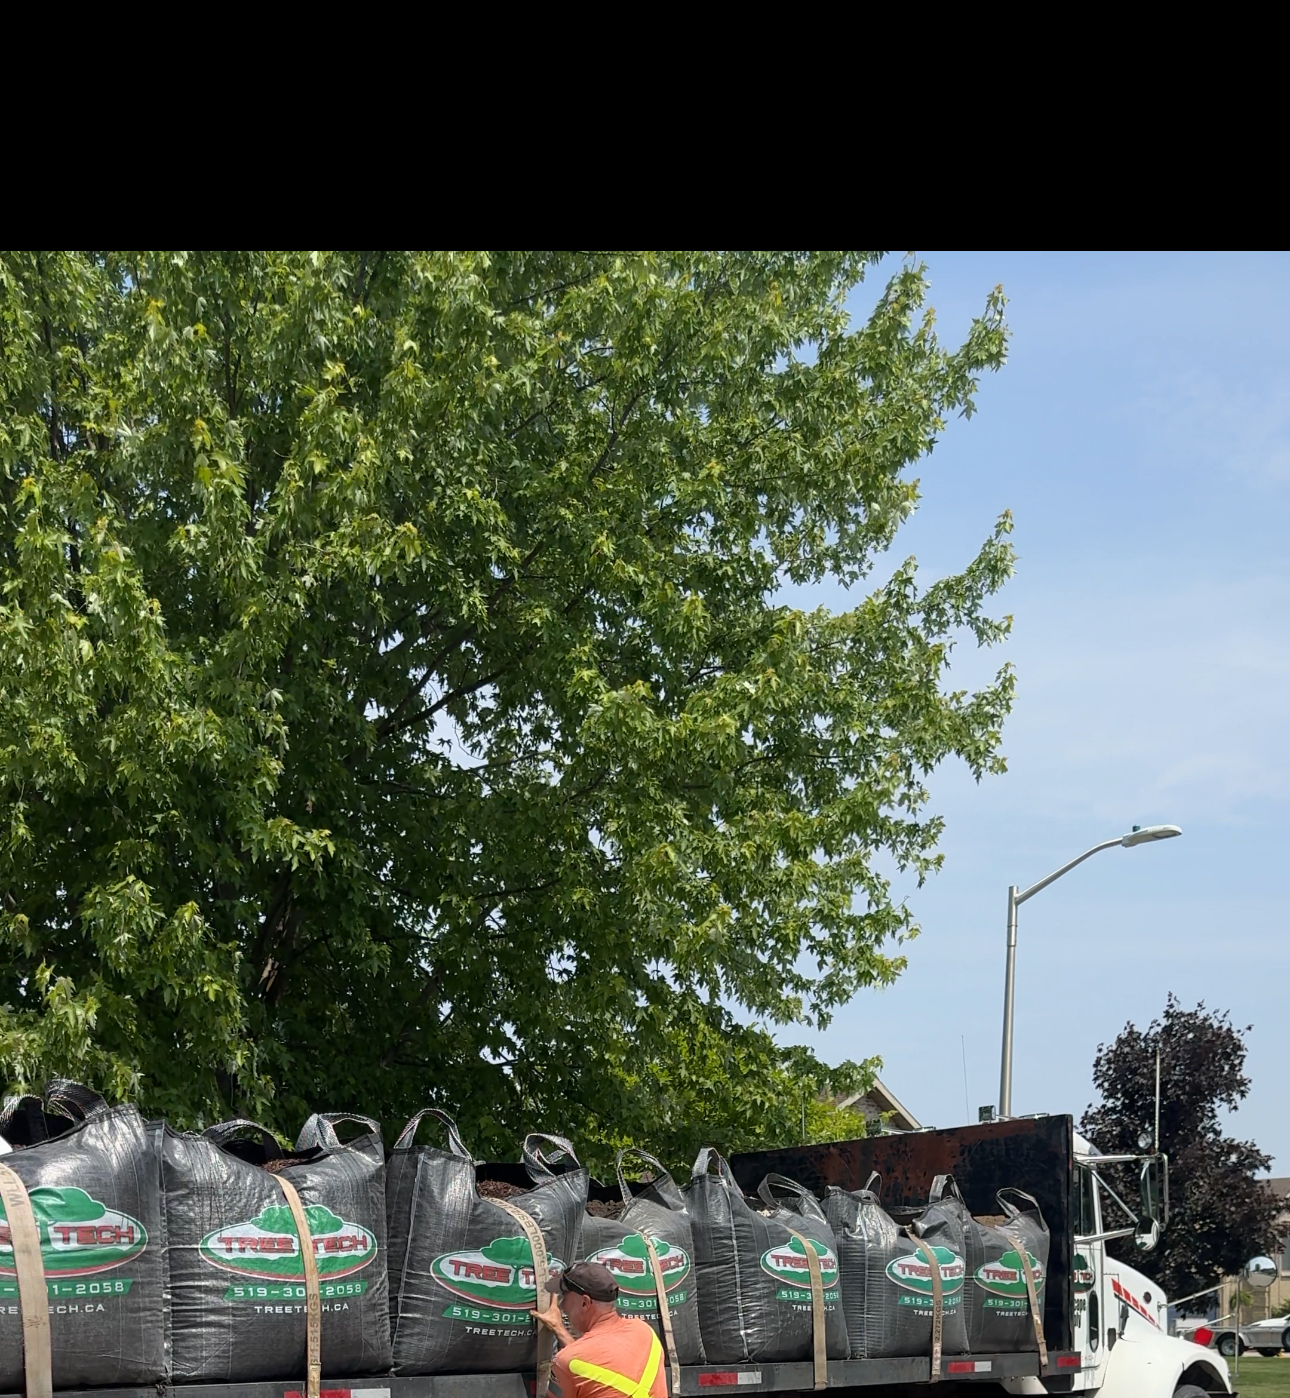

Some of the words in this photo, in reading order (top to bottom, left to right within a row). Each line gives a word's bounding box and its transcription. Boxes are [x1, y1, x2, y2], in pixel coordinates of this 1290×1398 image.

[54, 1225, 135, 1245] TECH
[218, 1236, 294, 1254] TREE
[449, 1259, 511, 1283] TREE
[983, 1268, 1017, 1282] TREE
[4, 1282, 124, 1295] -1-2058
[234, 1284, 362, 1297] 519-30-2058
[617, 1293, 684, 1308] 19-301058
[988, 1299, 1041, 1307] 519-301-
[254, 1303, 349, 1314] TREETEH.CA
[792, 1304, 835, 1312] TREEH.CA
[465, 1326, 535, 1337] TREETECH.C
